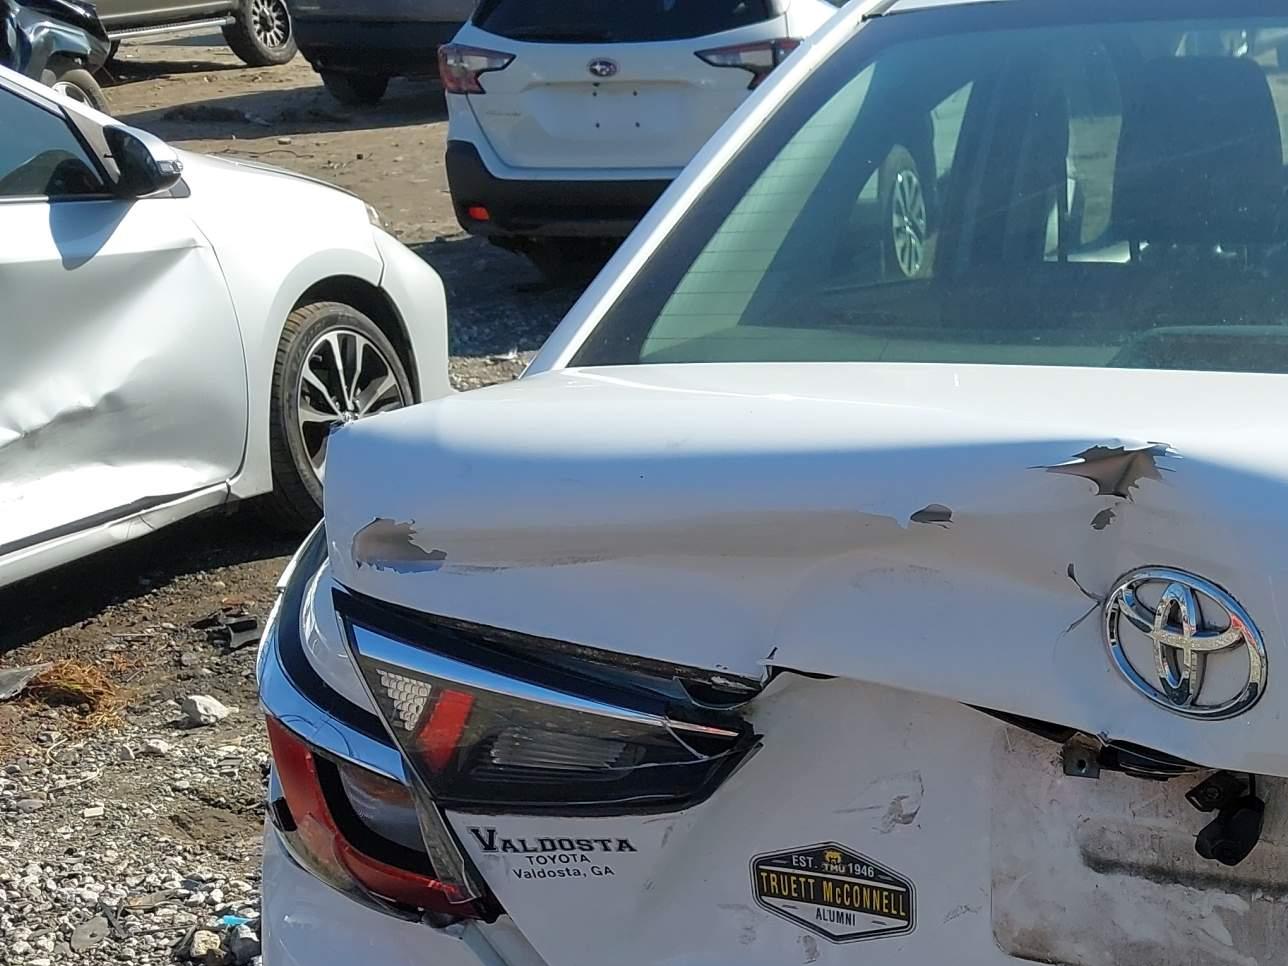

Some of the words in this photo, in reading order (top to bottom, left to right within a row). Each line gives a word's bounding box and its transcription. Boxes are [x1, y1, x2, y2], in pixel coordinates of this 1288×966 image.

[467, 826, 638, 853] VALDOSTA
[525, 853, 591, 866] TOYOTA
[792, 855, 818, 869] EST.
[822, 863, 846, 873] TMU
[848, 863, 875, 878] 1946
[512, 866, 587, 880] Valdosta,
[590, 865, 615, 877] GA
[760, 871, 815, 900] TRUETT
[823, 880, 907, 917] McCONNELL
[815, 907, 856, 927] ALUMNI
